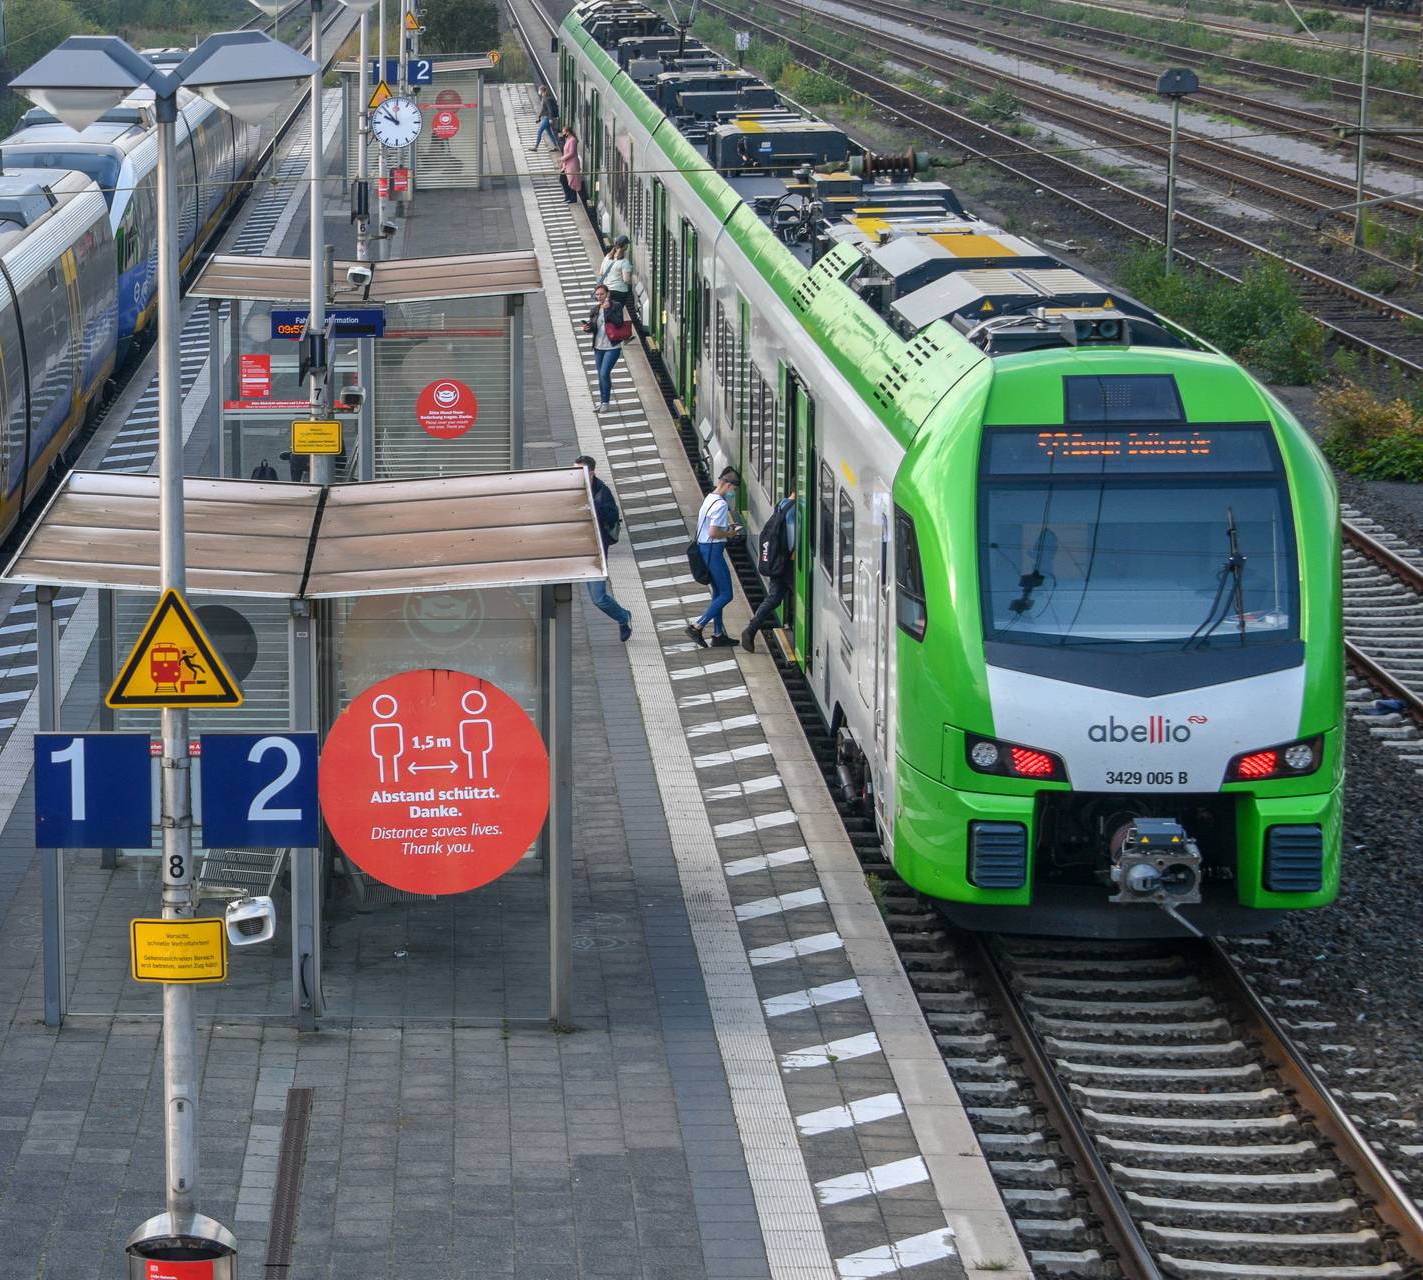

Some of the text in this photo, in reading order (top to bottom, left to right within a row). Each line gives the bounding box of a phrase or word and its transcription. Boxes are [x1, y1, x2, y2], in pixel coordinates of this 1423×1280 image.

[417, 60, 430, 80] 2
[360, 223, 366, 233] 6
[314, 388, 322, 400] 7
[762, 540, 770, 561] FILA
[1088, 715, 1190, 743] abellio
[412, 735, 451, 750] 1,5 m
[51, 738, 85, 820] 1
[247, 736, 302, 820] 2
[1106, 771, 1189, 785] 3429 005 B
[370, 786, 500, 803] Abstand schützt.
[409, 805, 463, 819] Danke.
[371, 823, 503, 840] Distance saves lives.
[401, 842, 474, 857] Thank you.
[169, 854, 185, 879] 8
